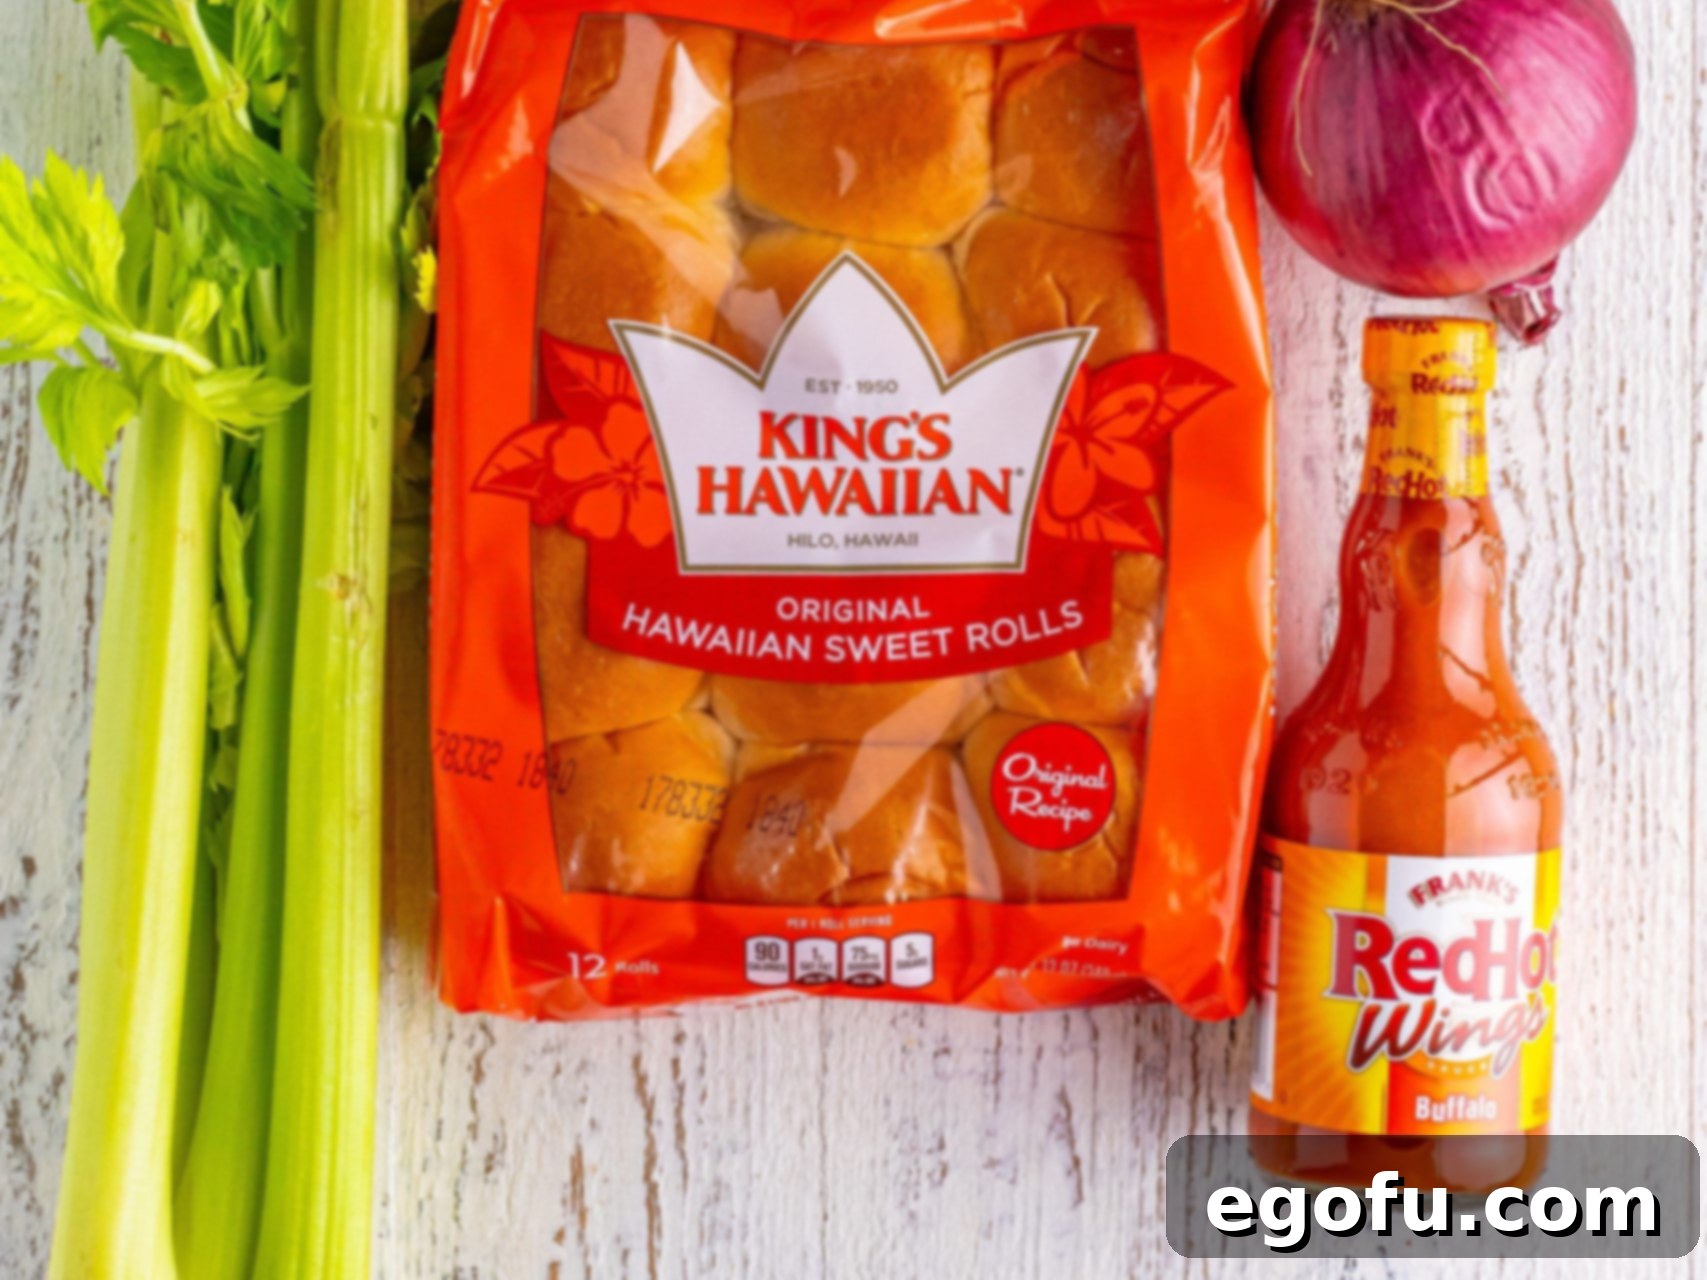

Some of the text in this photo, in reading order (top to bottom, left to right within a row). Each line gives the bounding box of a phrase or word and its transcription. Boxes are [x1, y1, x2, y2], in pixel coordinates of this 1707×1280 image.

[804, 378, 898, 394] EST 1950
[758, 410, 953, 462] KING'S
[697, 466, 1013, 517] HAWAIIAN
[787, 532, 919, 550] HILO, HAWAII
[776, 596, 931, 622] ORIGINAL
[622, 600, 1084, 663] HAWAIIAN SWEET ROLLS
[1002, 752, 1107, 798] Original
[1008, 786, 1093, 832] Recipe
[1409, 870, 1520, 907] FRANK'S
[566, 951, 607, 980] 12
[754, 941, 781, 962] 90
[1348, 996, 1547, 1078] Wings
[1414, 1095, 1497, 1121] Buffalo
